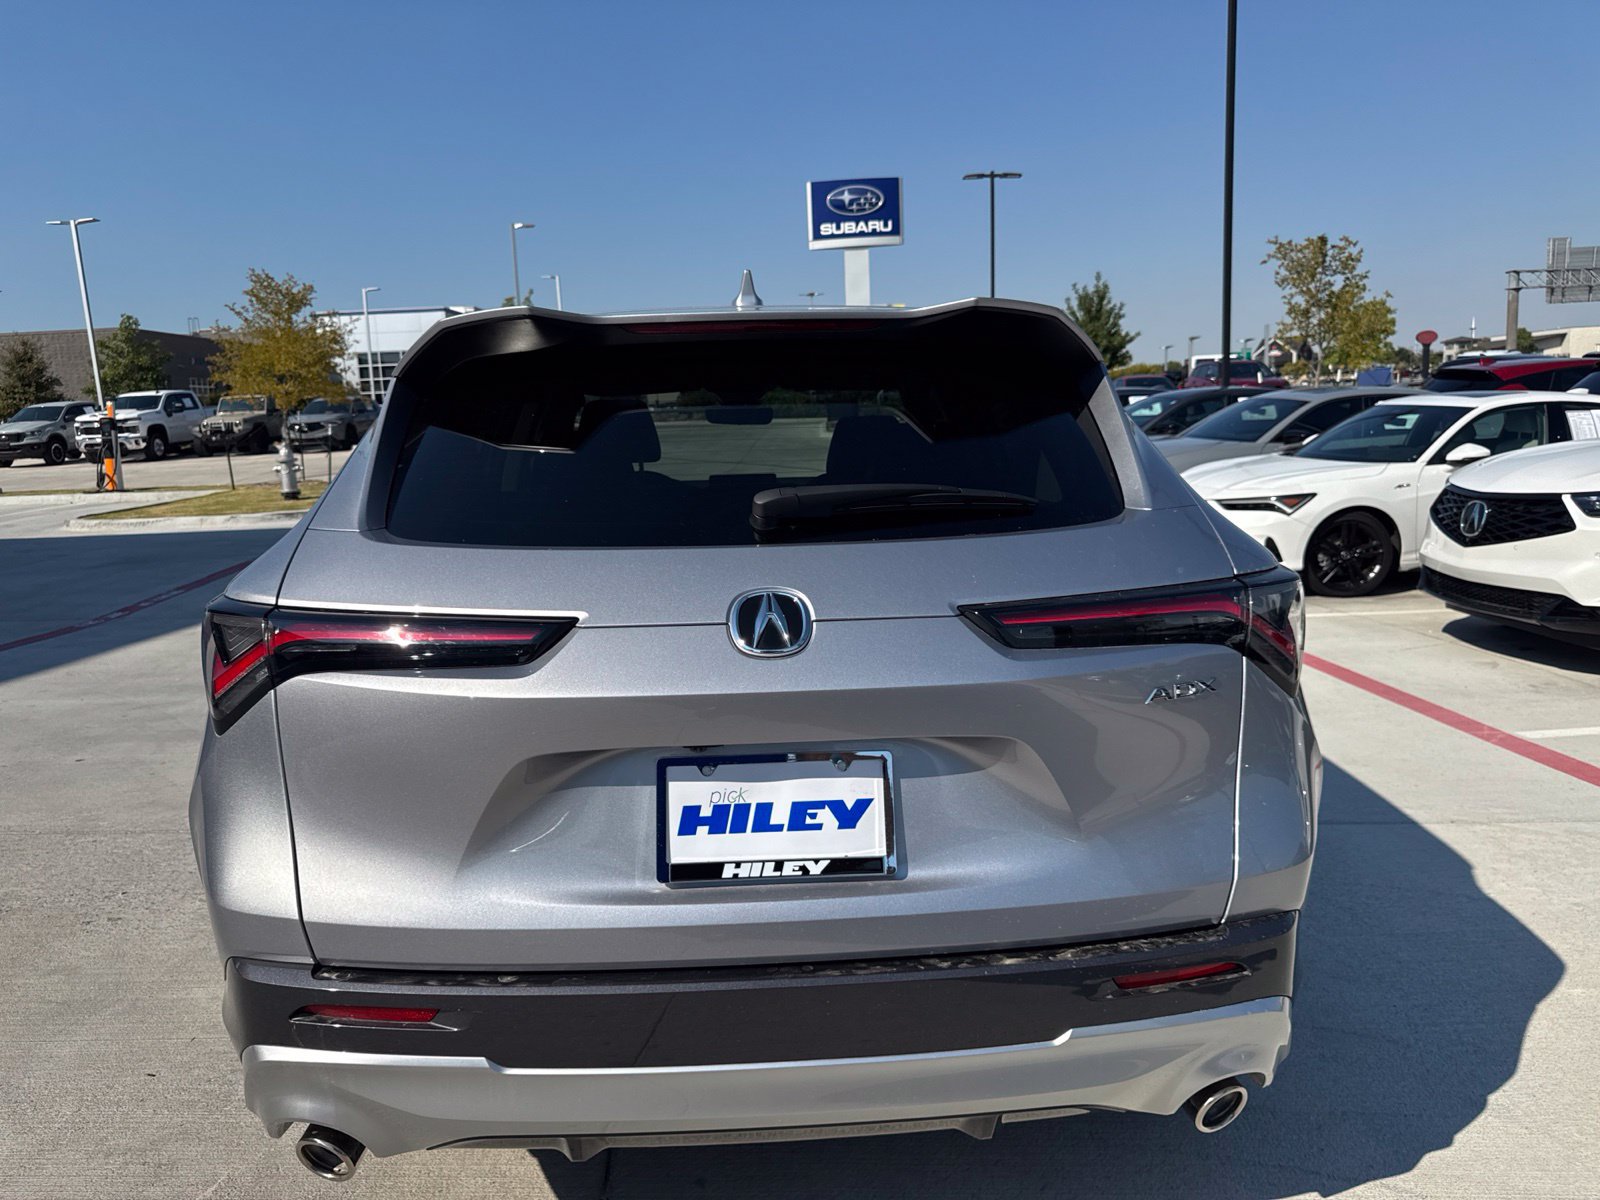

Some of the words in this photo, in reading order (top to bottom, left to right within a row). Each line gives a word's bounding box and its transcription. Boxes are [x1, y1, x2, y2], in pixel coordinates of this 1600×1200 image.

[819, 219, 893, 236] SUBARU
[1144, 677, 1217, 705] ADX
[708, 786, 749, 807] pick
[677, 797, 875, 837] HILEY
[721, 859, 831, 879] HILEY
